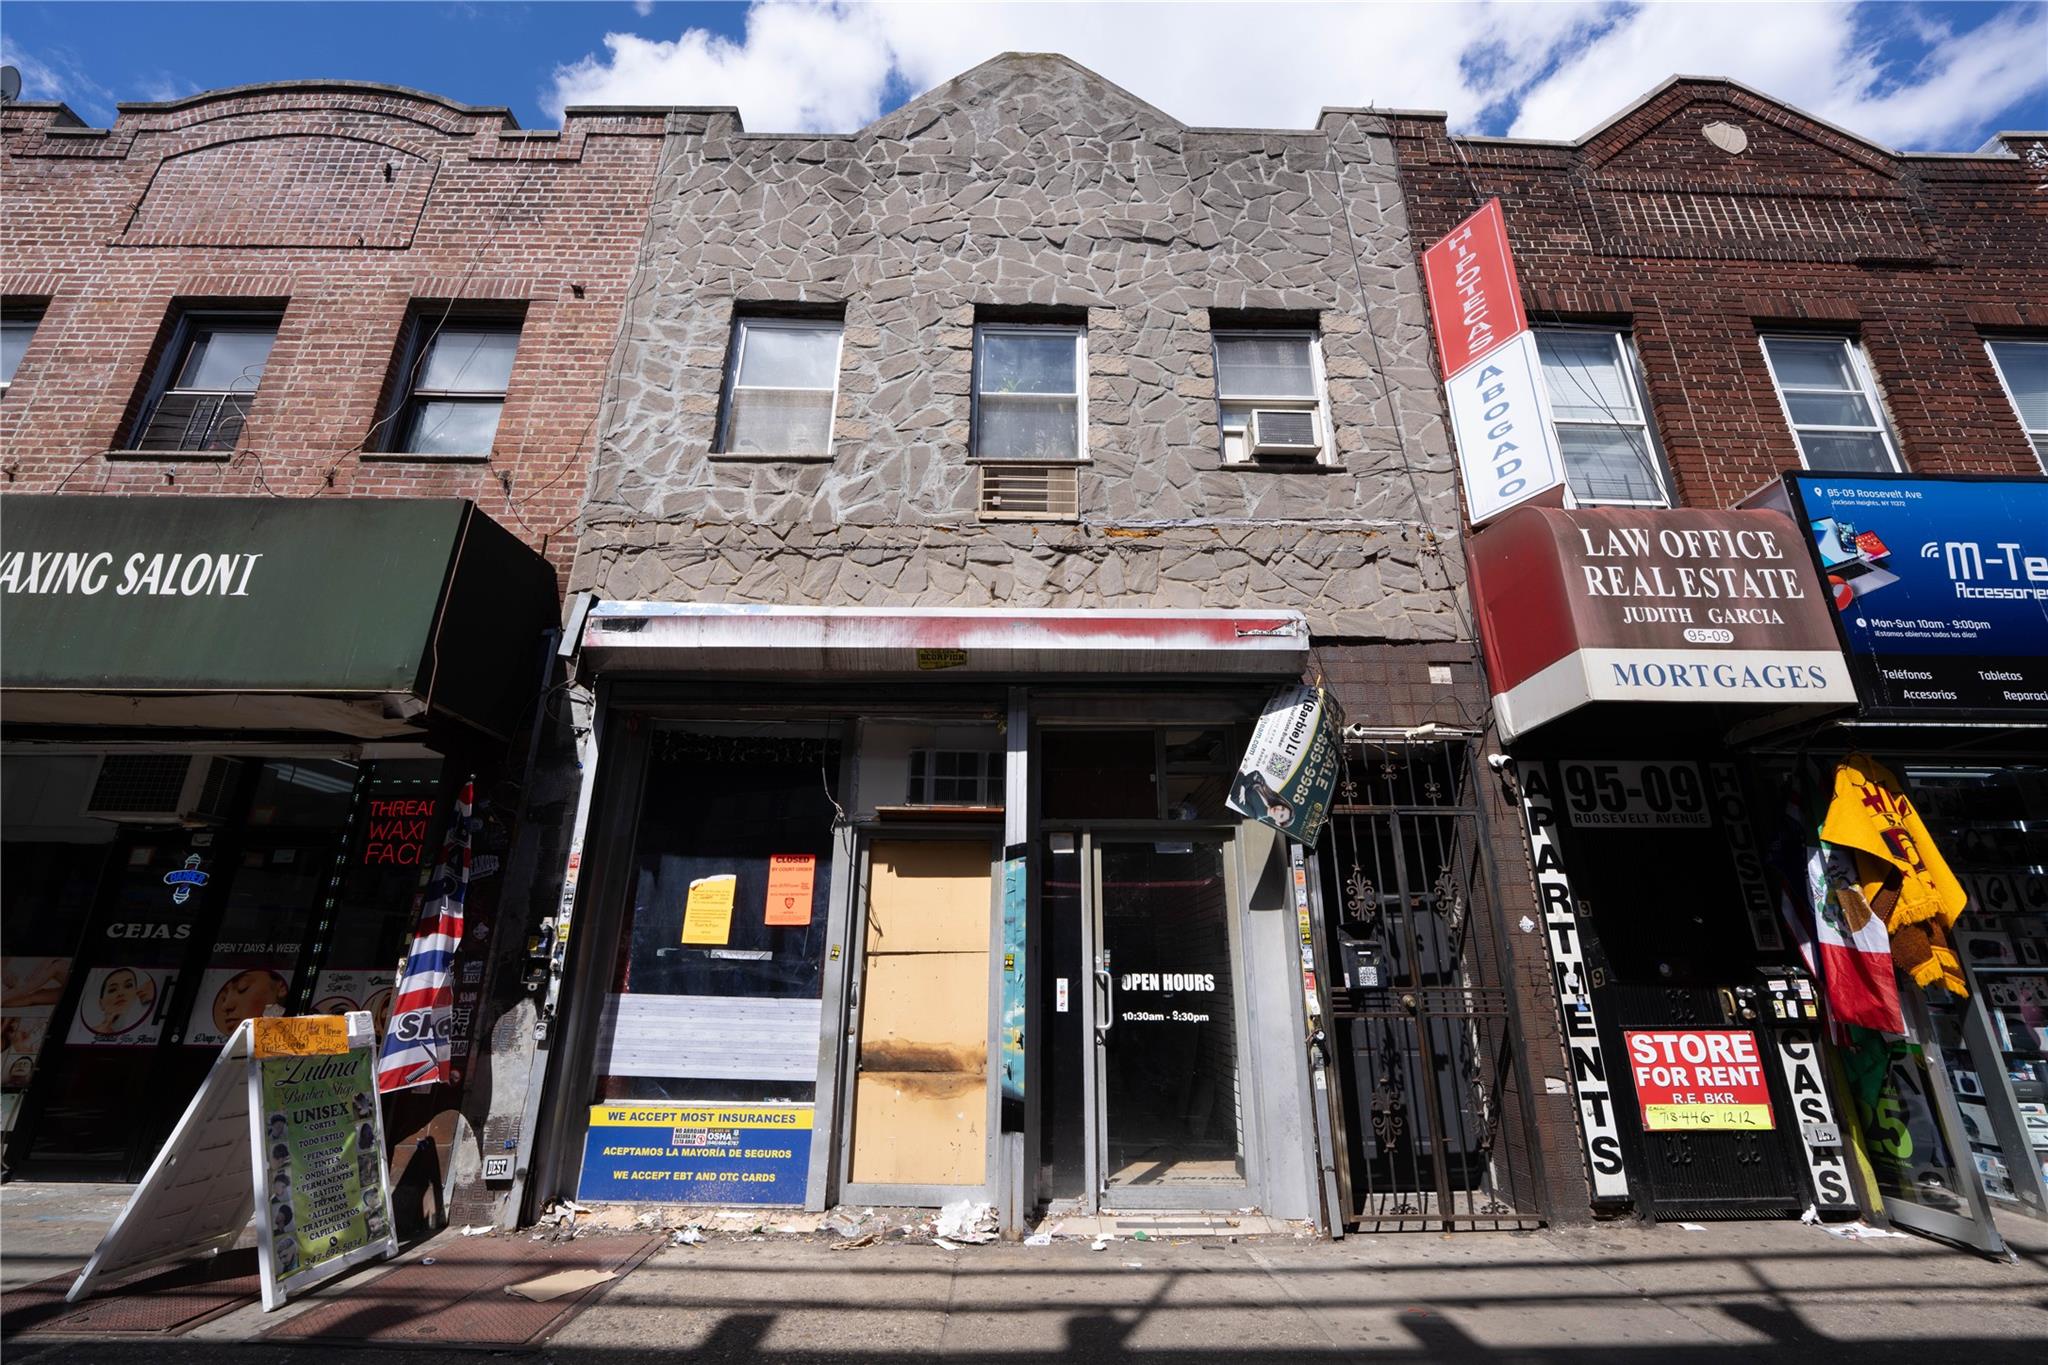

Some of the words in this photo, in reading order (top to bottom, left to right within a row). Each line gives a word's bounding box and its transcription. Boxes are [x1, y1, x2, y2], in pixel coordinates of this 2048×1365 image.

[1450, 226, 1494, 356] HIPOTECAS
[1476, 365, 1526, 498] ABOGADO
[1827, 488, 1855, 498] 95-09
[1857, 489, 1903, 499] Roosevelt
[1905, 490, 1923, 499] Ave
[1580, 528, 1650, 557] LAW
[1659, 529, 1783, 559] OFFICE
[116, 552, 263, 596] SALONI
[1582, 566, 1676, 597] REAL
[1676, 567, 1804, 599] ESTATE
[1955, 582, 2048, 599] Accessorie
[1623, 606, 1694, 625] JUDITH
[1708, 608, 1784, 625] GARCIA
[1871, 618, 1916, 629] Mon-Sun
[1917, 619, 1945, 629] 10am
[1952, 620, 1991, 631] 9:00pm
[1688, 629, 1730, 643] 95-09
[1612, 663, 1827, 689] MORTGAGES
[1882, 669, 1933, 680] Teléfonos
[1978, 671, 2023, 681] Tabletas
[1903, 689, 1957, 701] Accesorios
[1288, 700, 1316, 747] (Barbie)
[1285, 744, 1296, 757] Li
[1565, 765, 1707, 814] 95-09
[1575, 812, 1650, 824] ROOSEVELT
[1656, 813, 1707, 824] AVENUE
[107, 923, 192, 939] CEJAS
[213, 944, 236, 953] OPEN
[244, 944, 265, 953] DAYS
[266, 944, 274, 953] A
[276, 944, 302, 953] WEEK
[1523, 769, 1623, 1174] APARTMENTS
[1122, 973, 1160, 991] OPEN
[1163, 973, 1216, 992] HOURS
[1122, 1011, 1165, 1022] 10:30am
[1630, 1034, 1758, 1064] STORE
[274, 1056, 359, 1087] Zulma
[1636, 1067, 1689, 1087] FOR
[1696, 1066, 1761, 1087] RENT
[1673, 1093, 1700, 1104] R.E.
[1705, 1093, 1739, 1105] BKR.
[293, 1102, 350, 1124] UNISEX
[608, 1112, 626, 1121] WE
[629, 1112, 677, 1122] ACCEPT
[680, 1113, 715, 1122] MOST
[718, 1113, 796, 1124] INSURANCES
[1723, 1110, 1756, 1125] 1212
[309, 1120, 337, 1131] CORTES
[298, 1136, 319, 1149] TODO
[320, 1131, 345, 1143] ESTILO
[707, 1132, 732, 1141] OSHA
[307, 1147, 343, 1161] PEINADOS
[603, 1146, 664, 1156] ACEPTAMOS
[666, 1147, 679, 1156] LA
[681, 1146, 726, 1157] MAYORÍA
[729, 1148, 742, 1157] DE
[744, 1148, 792, 1158] SEGUROS
[314, 1156, 341, 1169] TINTES
[305, 1163, 350, 1181] ONDULADOS
[613, 1170, 628, 1180] WE
[631, 1171, 671, 1180] ACCEPT
[673, 1171, 693, 1181] EBT
[696, 1172, 717, 1181] AND
[719, 1172, 739, 1181] OTC
[742, 1172, 776, 1182] CARDS
[301, 1172, 354, 1193] PERMANENTES
[313, 1184, 344, 1199] RAYITOS
[313, 1193, 347, 1208] TRENZAS
[311, 1202, 348, 1220] ALIZADOS
[303, 1207, 360, 1233] TRATAMIENTOS
[309, 1221, 352, 1241] CAPILARES
